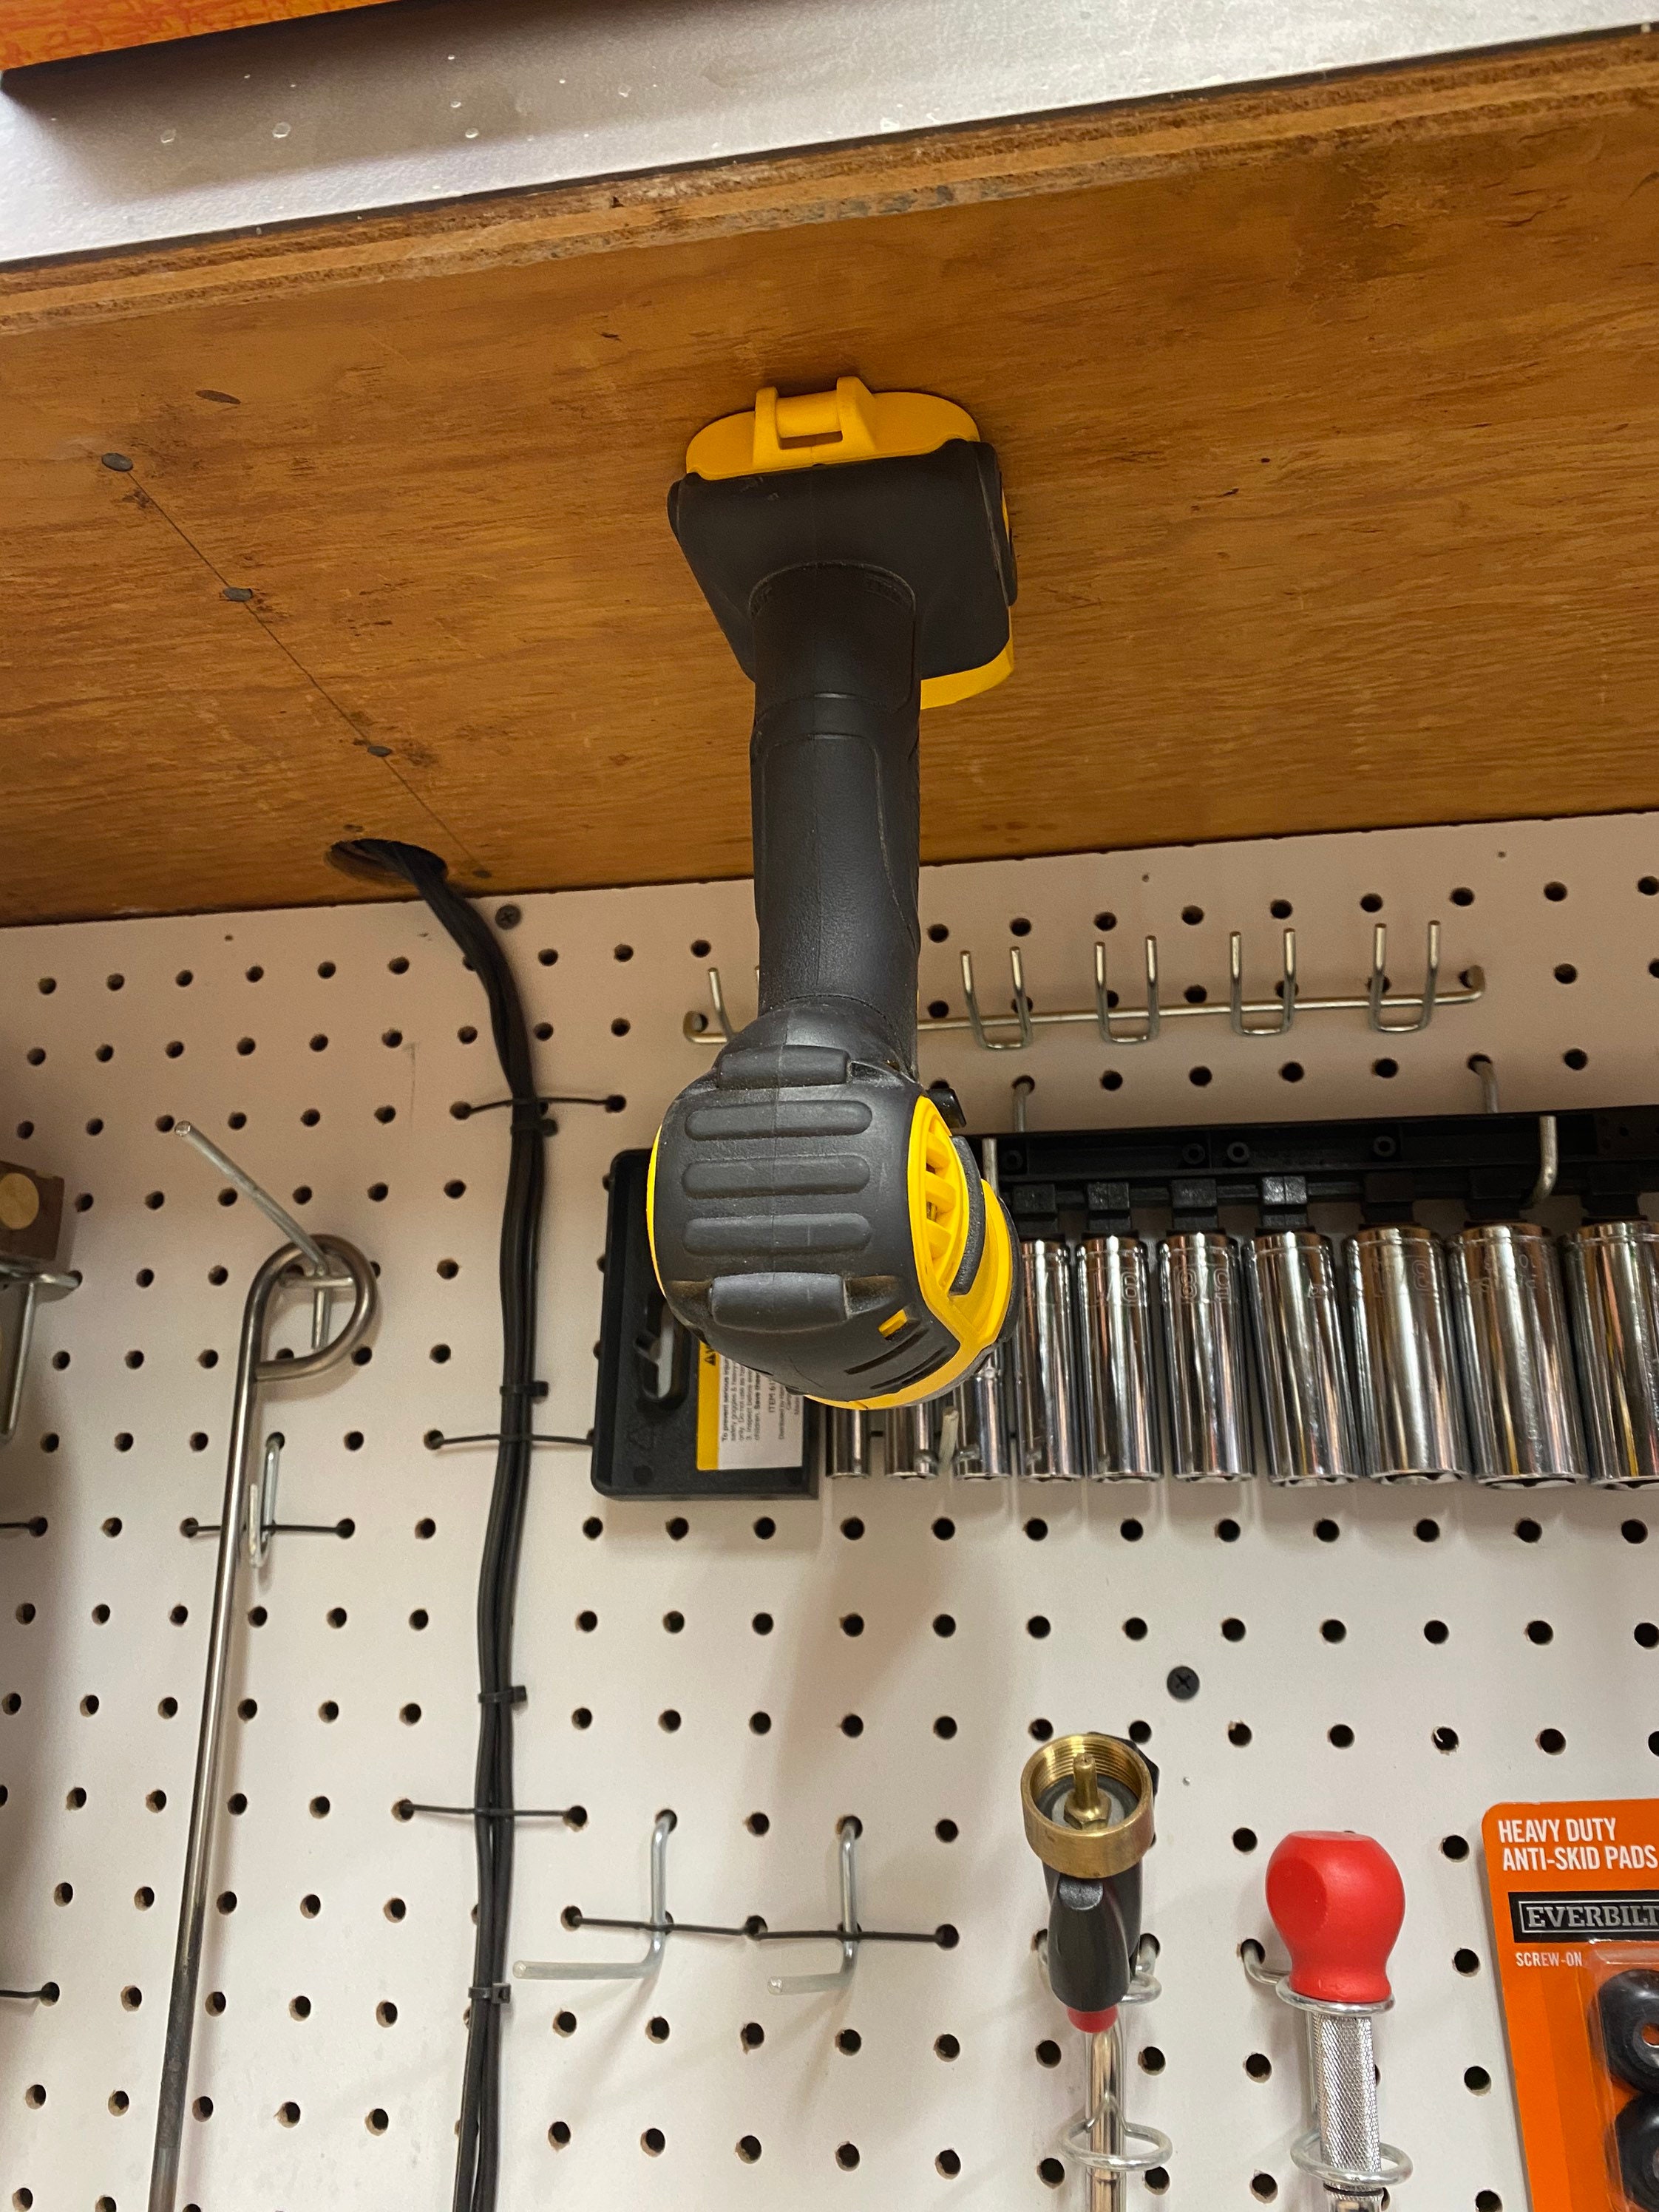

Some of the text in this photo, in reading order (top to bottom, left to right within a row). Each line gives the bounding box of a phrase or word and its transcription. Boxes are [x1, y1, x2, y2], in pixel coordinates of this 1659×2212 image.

[740, 1377, 744, 1385] as
[739, 1414, 744, 1422] Do
[722, 1433, 727, 1442] To
[1499, 1817, 1616, 1843] HEAVY DUTY
[1503, 1845, 1658, 1871] ANTI-SKID PADS
[1526, 1905, 1659, 1928] EVERBILT
[1516, 1952, 1583, 1967] SCREW-ON
